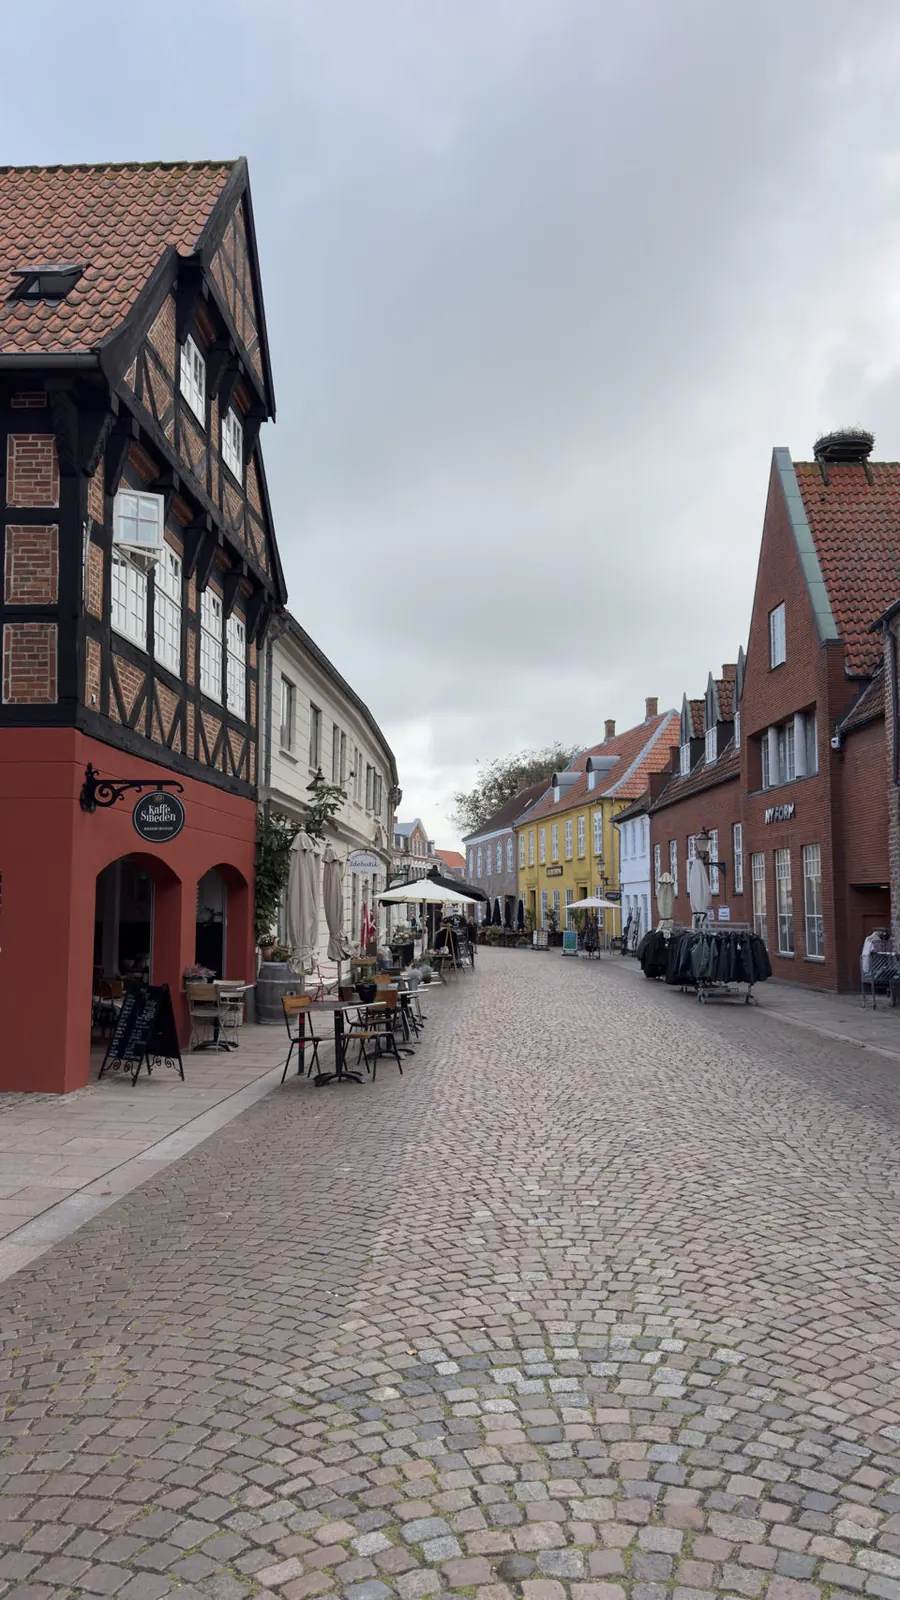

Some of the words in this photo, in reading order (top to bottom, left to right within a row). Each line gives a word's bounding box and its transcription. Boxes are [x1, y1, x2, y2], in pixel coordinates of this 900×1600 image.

[149, 804, 171, 815] Kaffe
[141, 811, 176, 822] Smeden
[765, 808, 774, 824] NY
